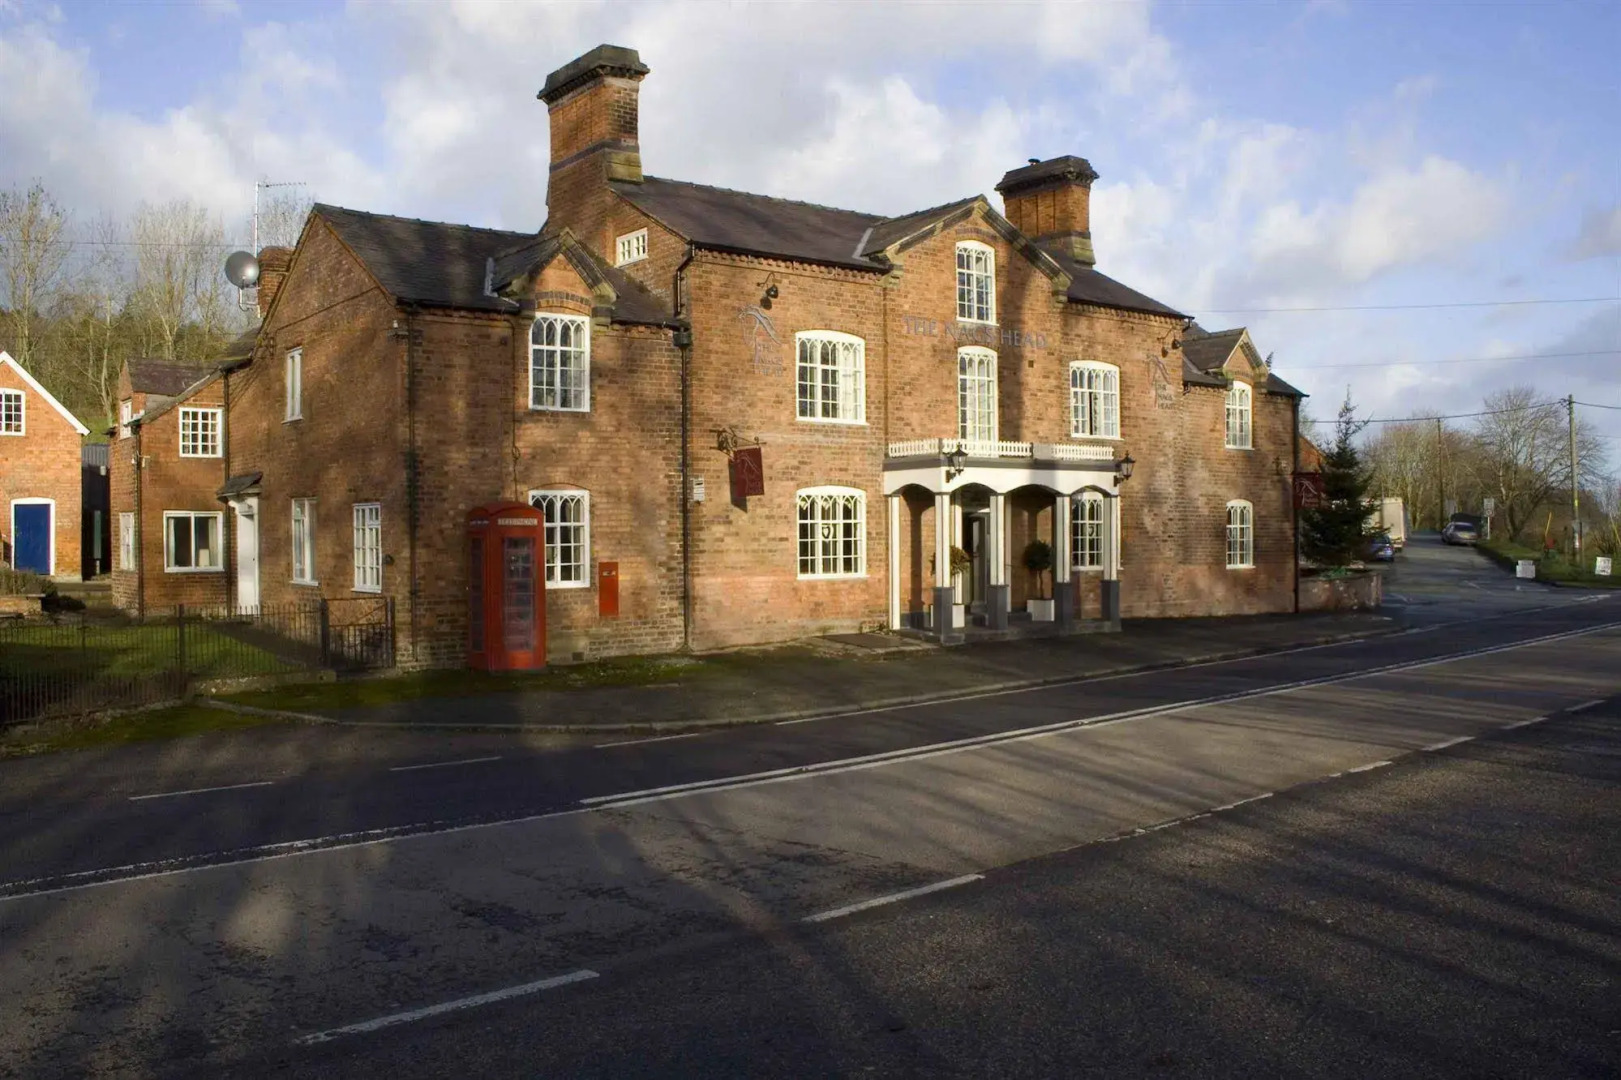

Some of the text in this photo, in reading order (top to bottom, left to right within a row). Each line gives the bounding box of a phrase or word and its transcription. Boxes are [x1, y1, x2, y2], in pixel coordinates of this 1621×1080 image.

[903, 315, 1047, 348] THE NAGS HEAD
